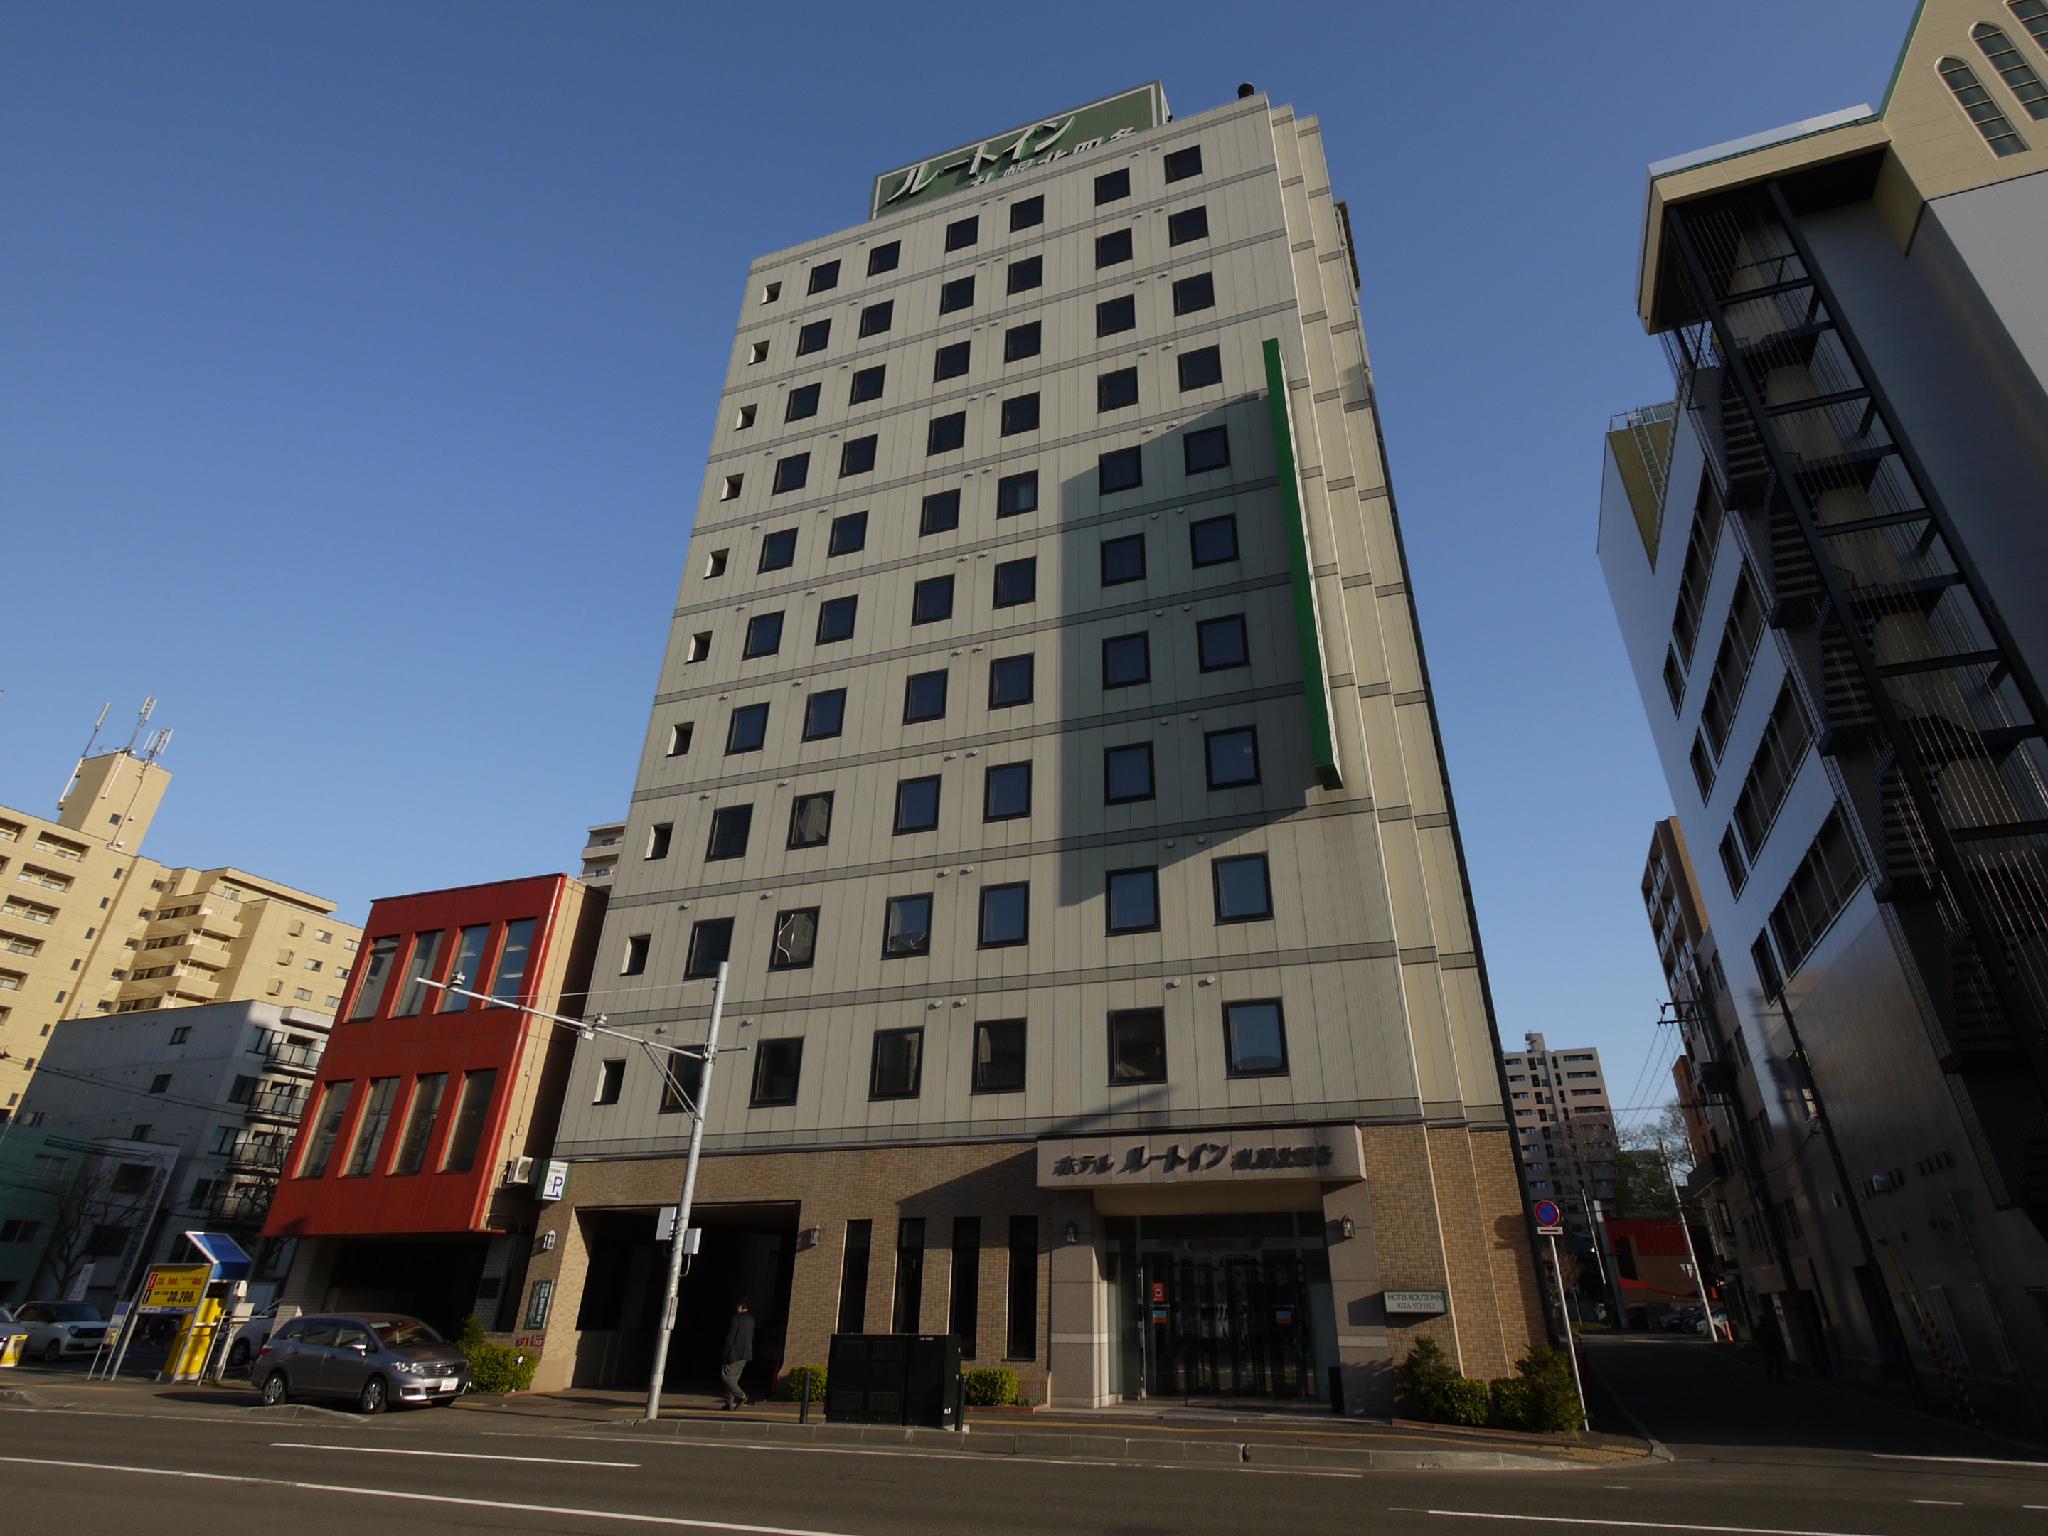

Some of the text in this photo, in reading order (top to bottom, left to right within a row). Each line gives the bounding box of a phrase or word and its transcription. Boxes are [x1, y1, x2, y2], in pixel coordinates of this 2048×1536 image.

[886, 115, 1075, 203] ルートイン
[1052, 1154, 1115, 1176] ホテル
[1116, 1143, 1229, 1174] ルートイン
[552, 1175, 563, 1193] P
